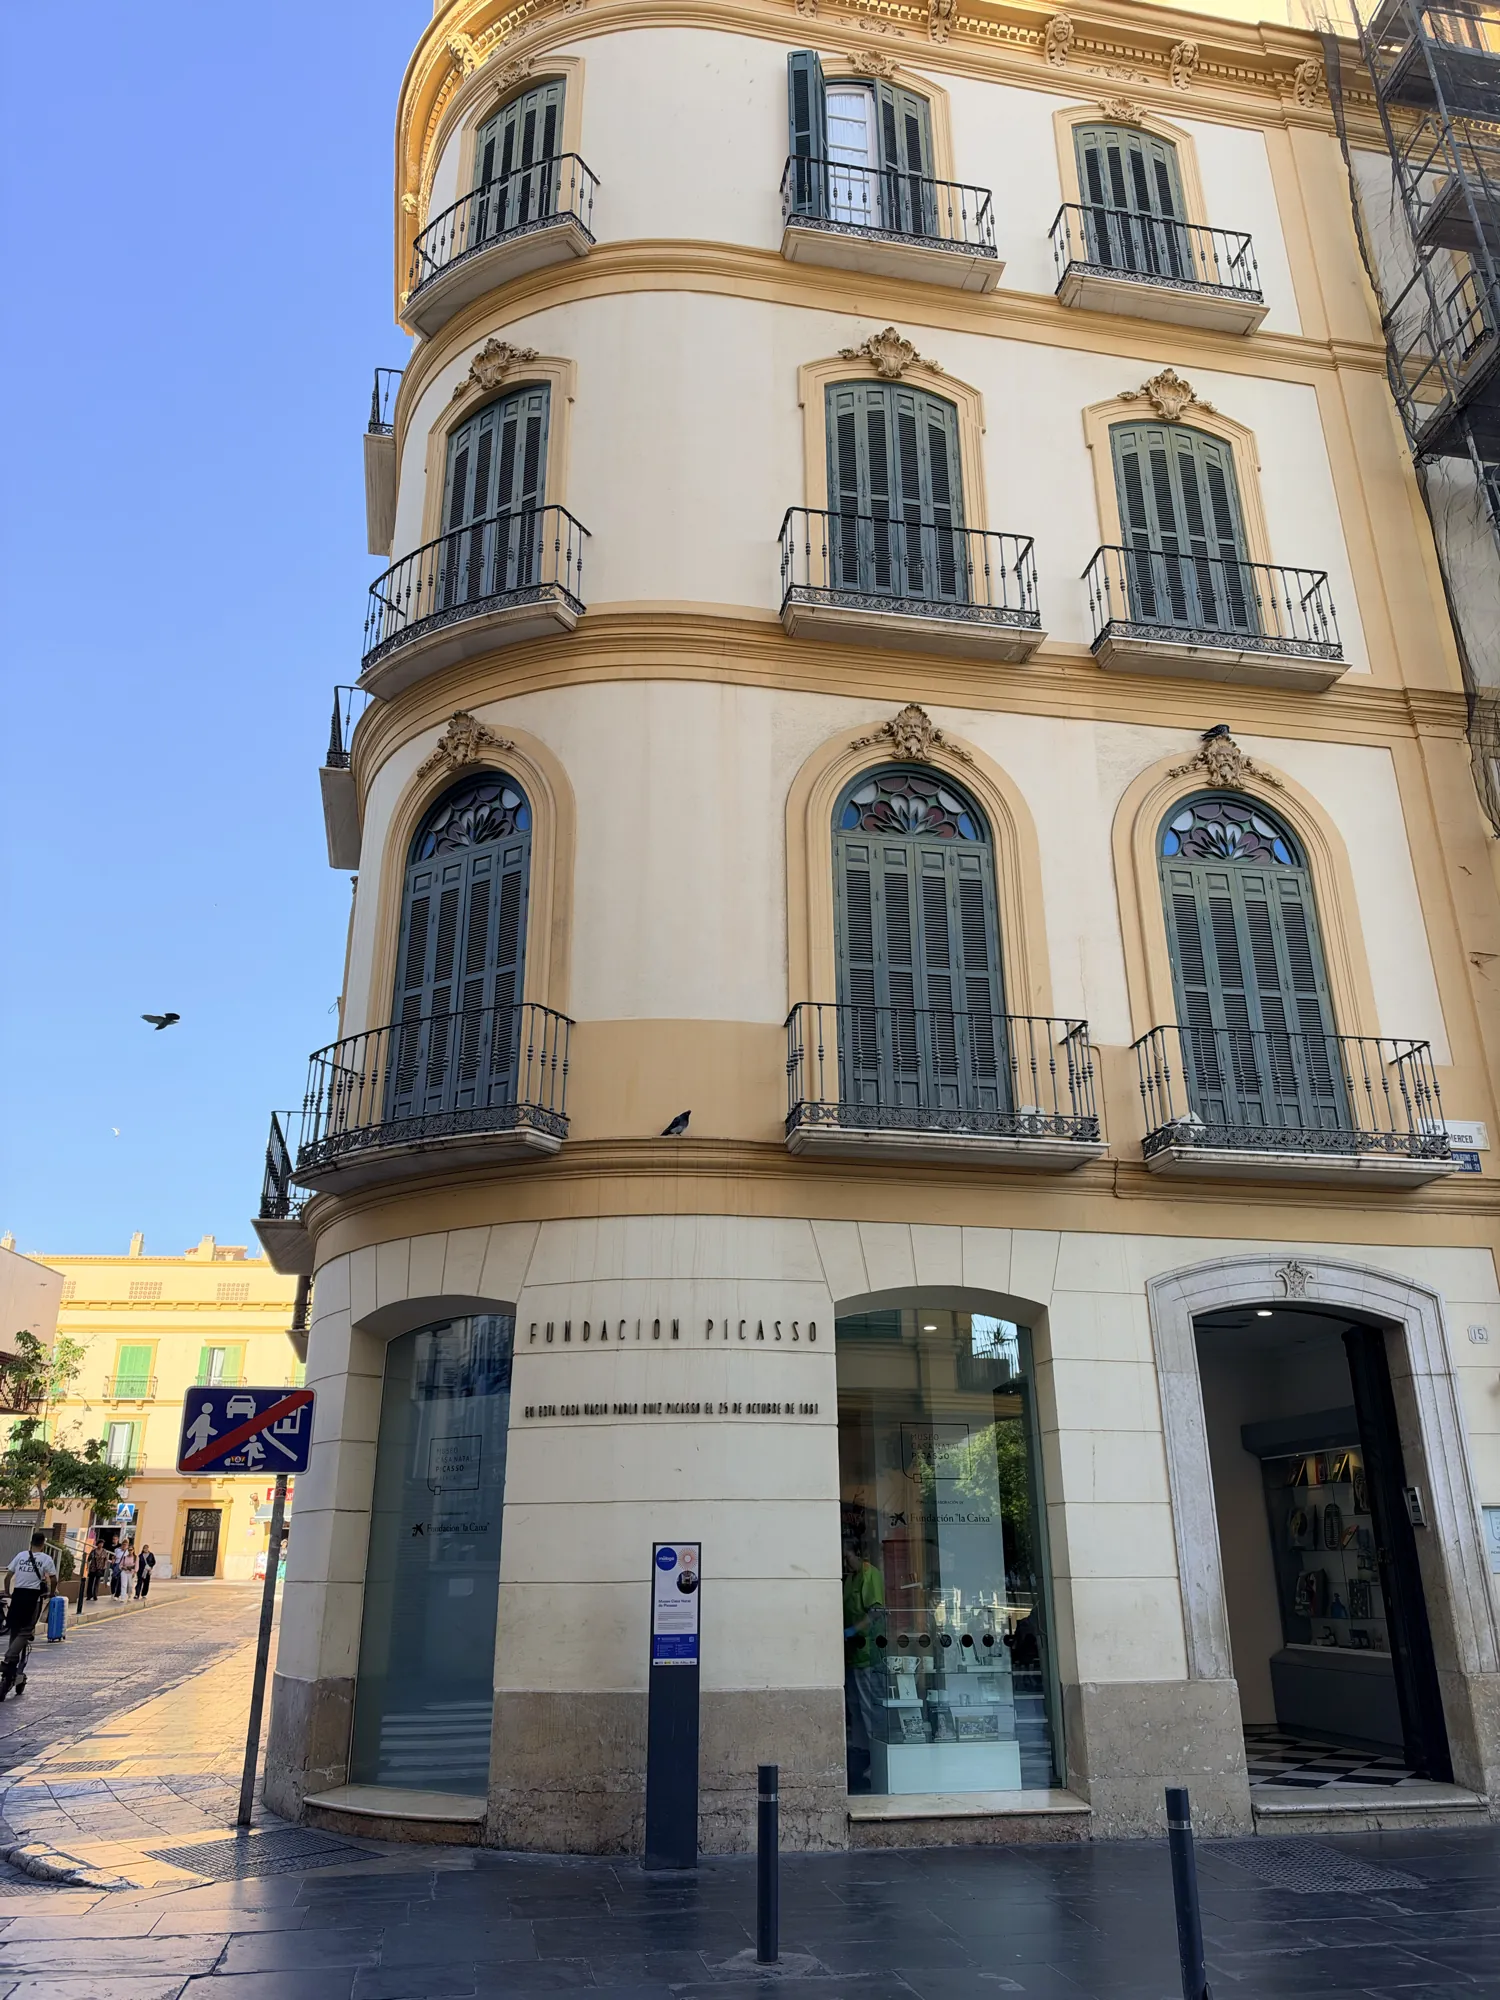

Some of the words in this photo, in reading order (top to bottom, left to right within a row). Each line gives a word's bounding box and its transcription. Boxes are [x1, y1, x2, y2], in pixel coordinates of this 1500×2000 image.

[530, 1318, 679, 1344] FUNDACION
[706, 1318, 816, 1342] PICASSO
[1473, 1328, 1484, 1340] 15
[525, 1405, 535, 1418] EN
[538, 1404, 556, 1418] ESTA
[560, 1403, 579, 1416] CASA
[613, 1402, 637, 1415] PABLO
[643, 1402, 662, 1415] RUIZ
[666, 1402, 700, 1415] PICASSO
[704, 1402, 713, 1415] EL
[718, 1402, 728, 1414] 25
[732, 1402, 743, 1415] DE
[746, 1402, 781, 1415] OCTUBRE
[785, 1402, 795, 1415] DE
[800, 1402, 819, 1415] 1881
[910, 1433, 939, 1441] MUSEO
[911, 1442, 932, 1450] CASA
[911, 1452, 950, 1460] PICASSO
[435, 1464, 465, 1473] PICASSO
[910, 1511, 954, 1522] Fundación
[19, 1559, 43, 1568] CALIN
